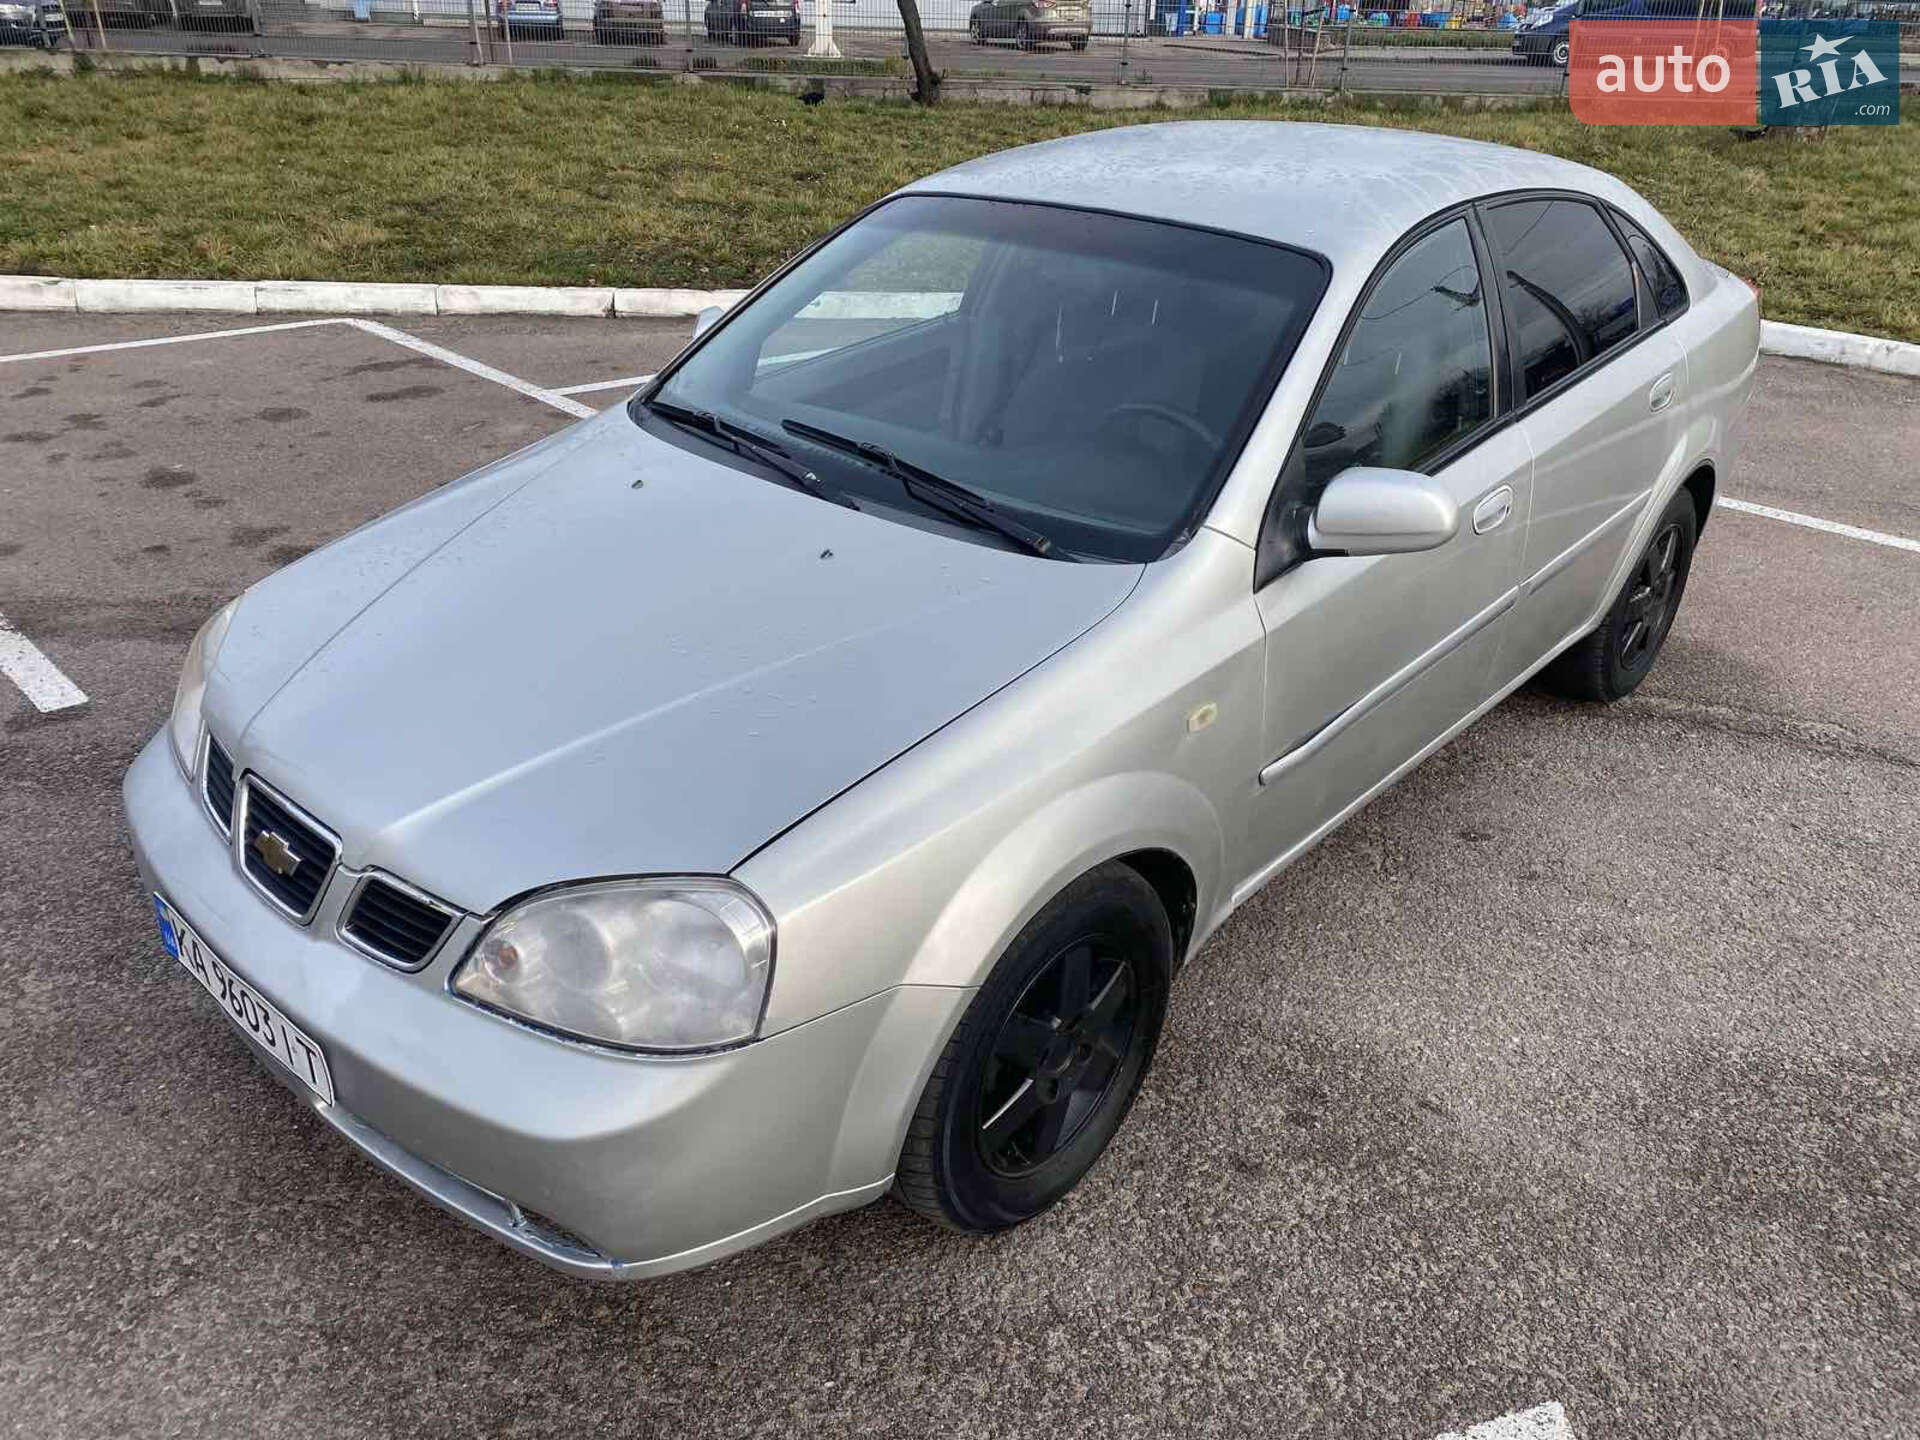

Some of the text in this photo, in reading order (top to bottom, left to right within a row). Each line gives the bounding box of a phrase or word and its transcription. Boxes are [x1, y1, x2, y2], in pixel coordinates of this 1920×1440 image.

[172, 919, 211, 986] KA
[212, 960, 276, 1047] 9603
[282, 1024, 318, 1085] IT
